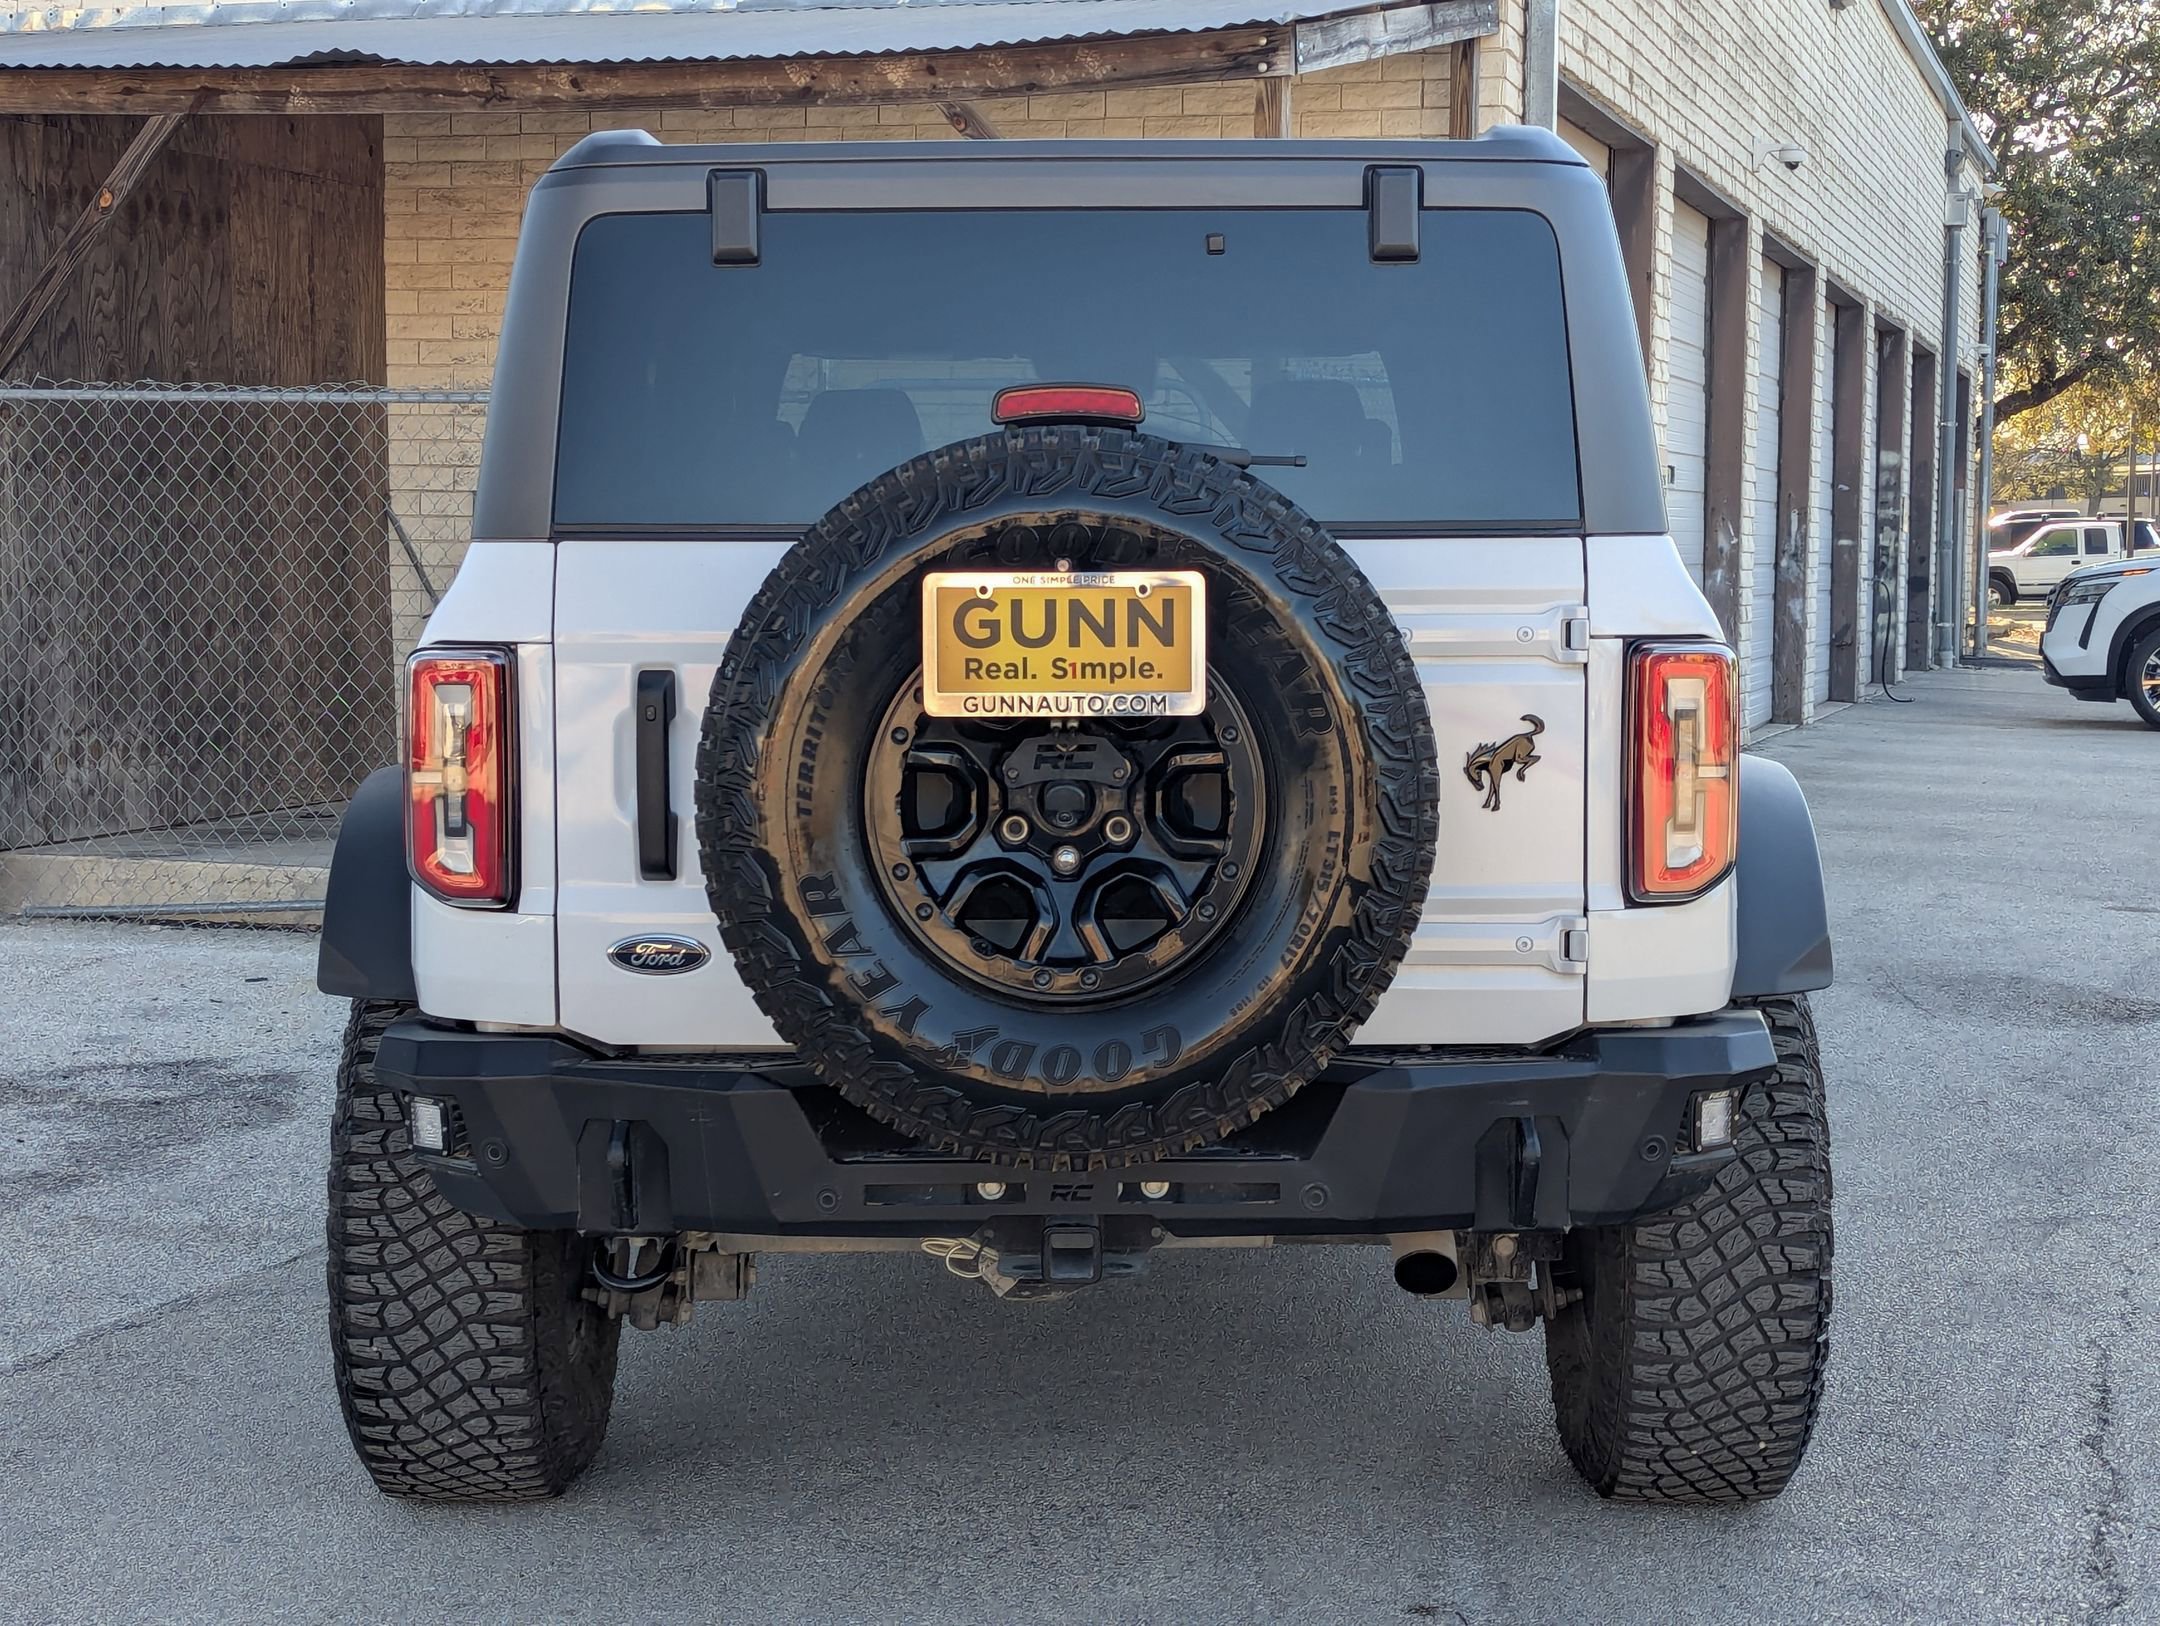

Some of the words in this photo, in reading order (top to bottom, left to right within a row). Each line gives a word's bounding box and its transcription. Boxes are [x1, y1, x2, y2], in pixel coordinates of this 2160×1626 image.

[1012, 575, 1035, 585] ONE
[1039, 575, 1079, 585] SIMPLE
[1081, 575, 1116, 585] PRICE
[952, 597, 1175, 650] GUNN
[964, 657, 1038, 681] Real.
[962, 695, 1168, 714] GUNNAUTO.COM
[630, 942, 688, 967] Ford
[1050, 1183, 1095, 1202] RC
